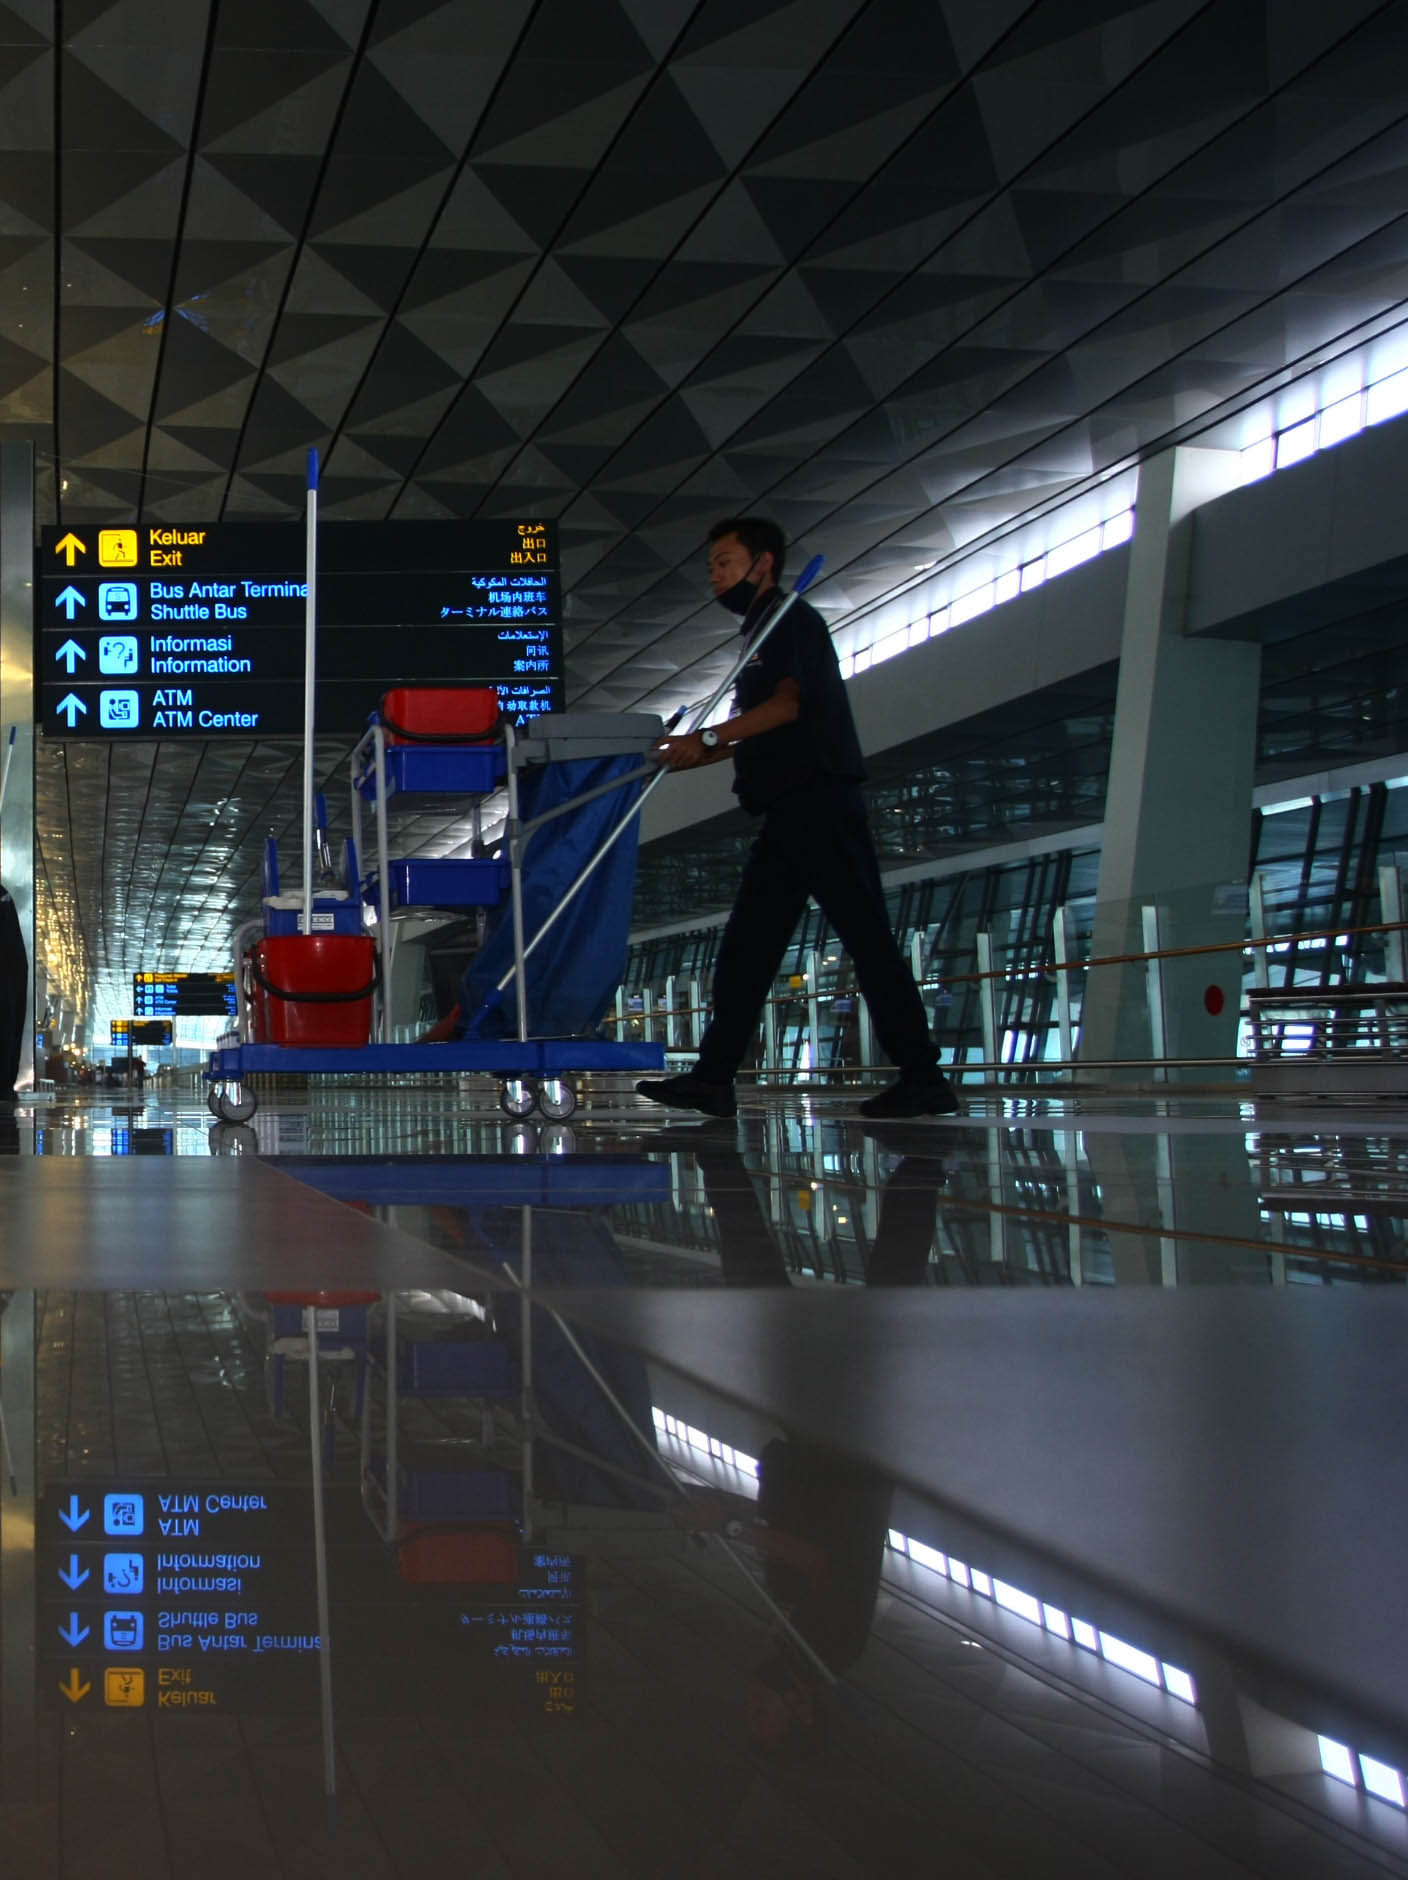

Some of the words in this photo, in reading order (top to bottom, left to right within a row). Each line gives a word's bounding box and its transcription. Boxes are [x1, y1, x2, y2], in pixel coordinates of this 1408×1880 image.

[150, 529, 206, 545] Keluar
[523, 537, 546, 549] 出口
[150, 550, 182, 566] Exit
[511, 552, 546, 563] 出入口
[150, 582, 184, 598] Bus
[189, 582, 236, 598] Antar
[241, 581, 309, 599] Termina
[151, 604, 210, 620] Shuttle
[215, 603, 248, 619] Bus
[151, 635, 232, 652] Informasi
[151, 656, 252, 674] Information
[152, 689, 192, 706] ATM
[153, 710, 193, 728] ATM
[198, 710, 258, 728] Center
